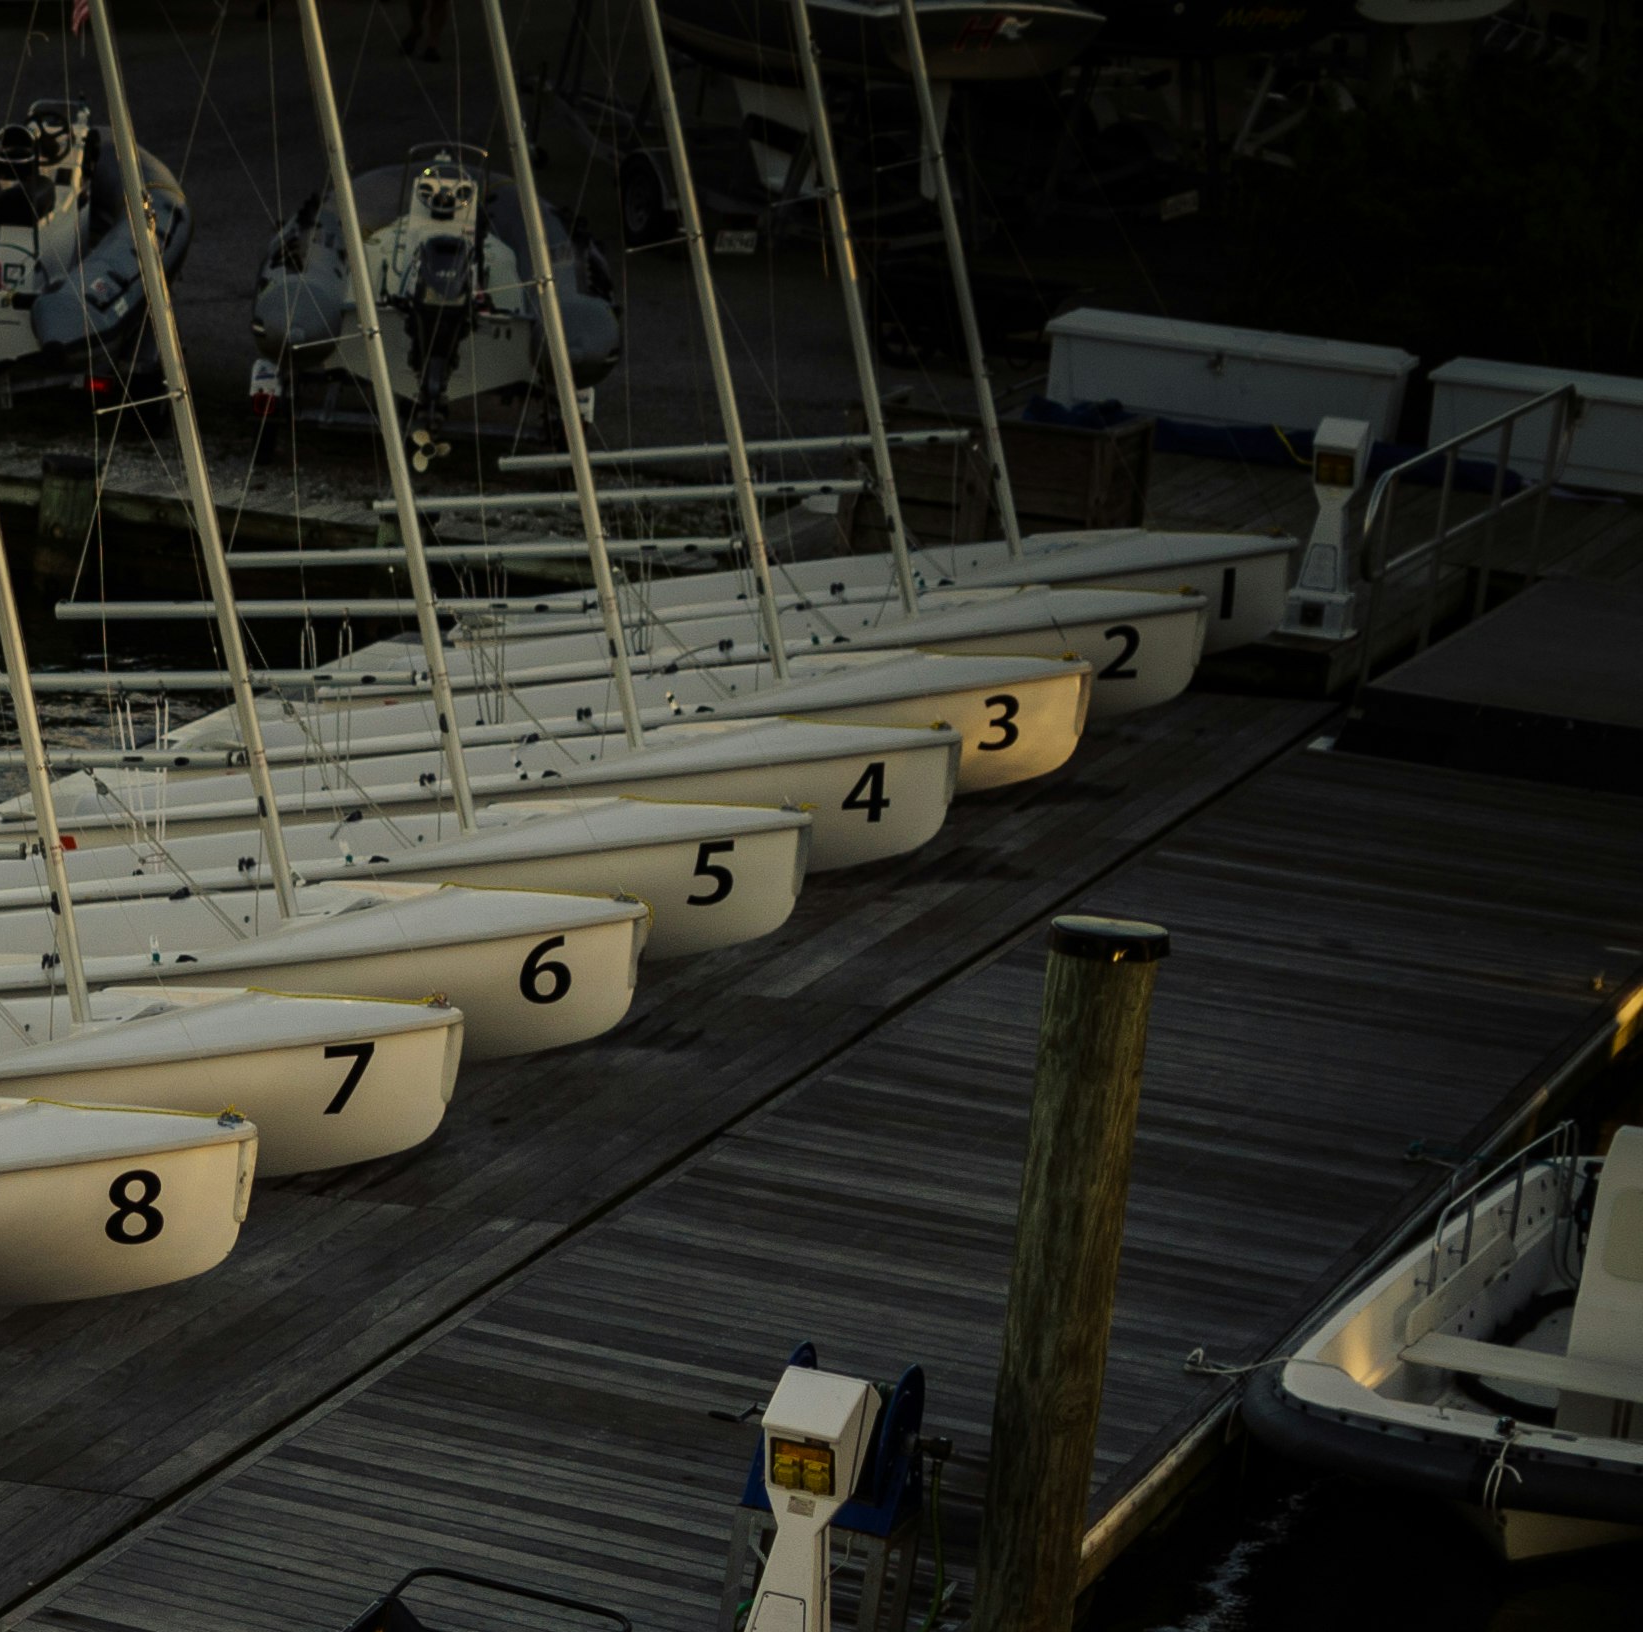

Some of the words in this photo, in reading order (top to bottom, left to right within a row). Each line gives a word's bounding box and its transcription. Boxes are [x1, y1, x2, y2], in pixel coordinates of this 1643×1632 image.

[1219, 567, 1236, 621] 1
[1097, 625, 1139, 682] 2
[977, 694, 1020, 752] 3
[841, 762, 891, 823] 4
[686, 839, 735, 907] 5
[519, 935, 572, 1005] 6
[323, 1041, 375, 1115] 7
[104, 1169, 164, 1245] 8
